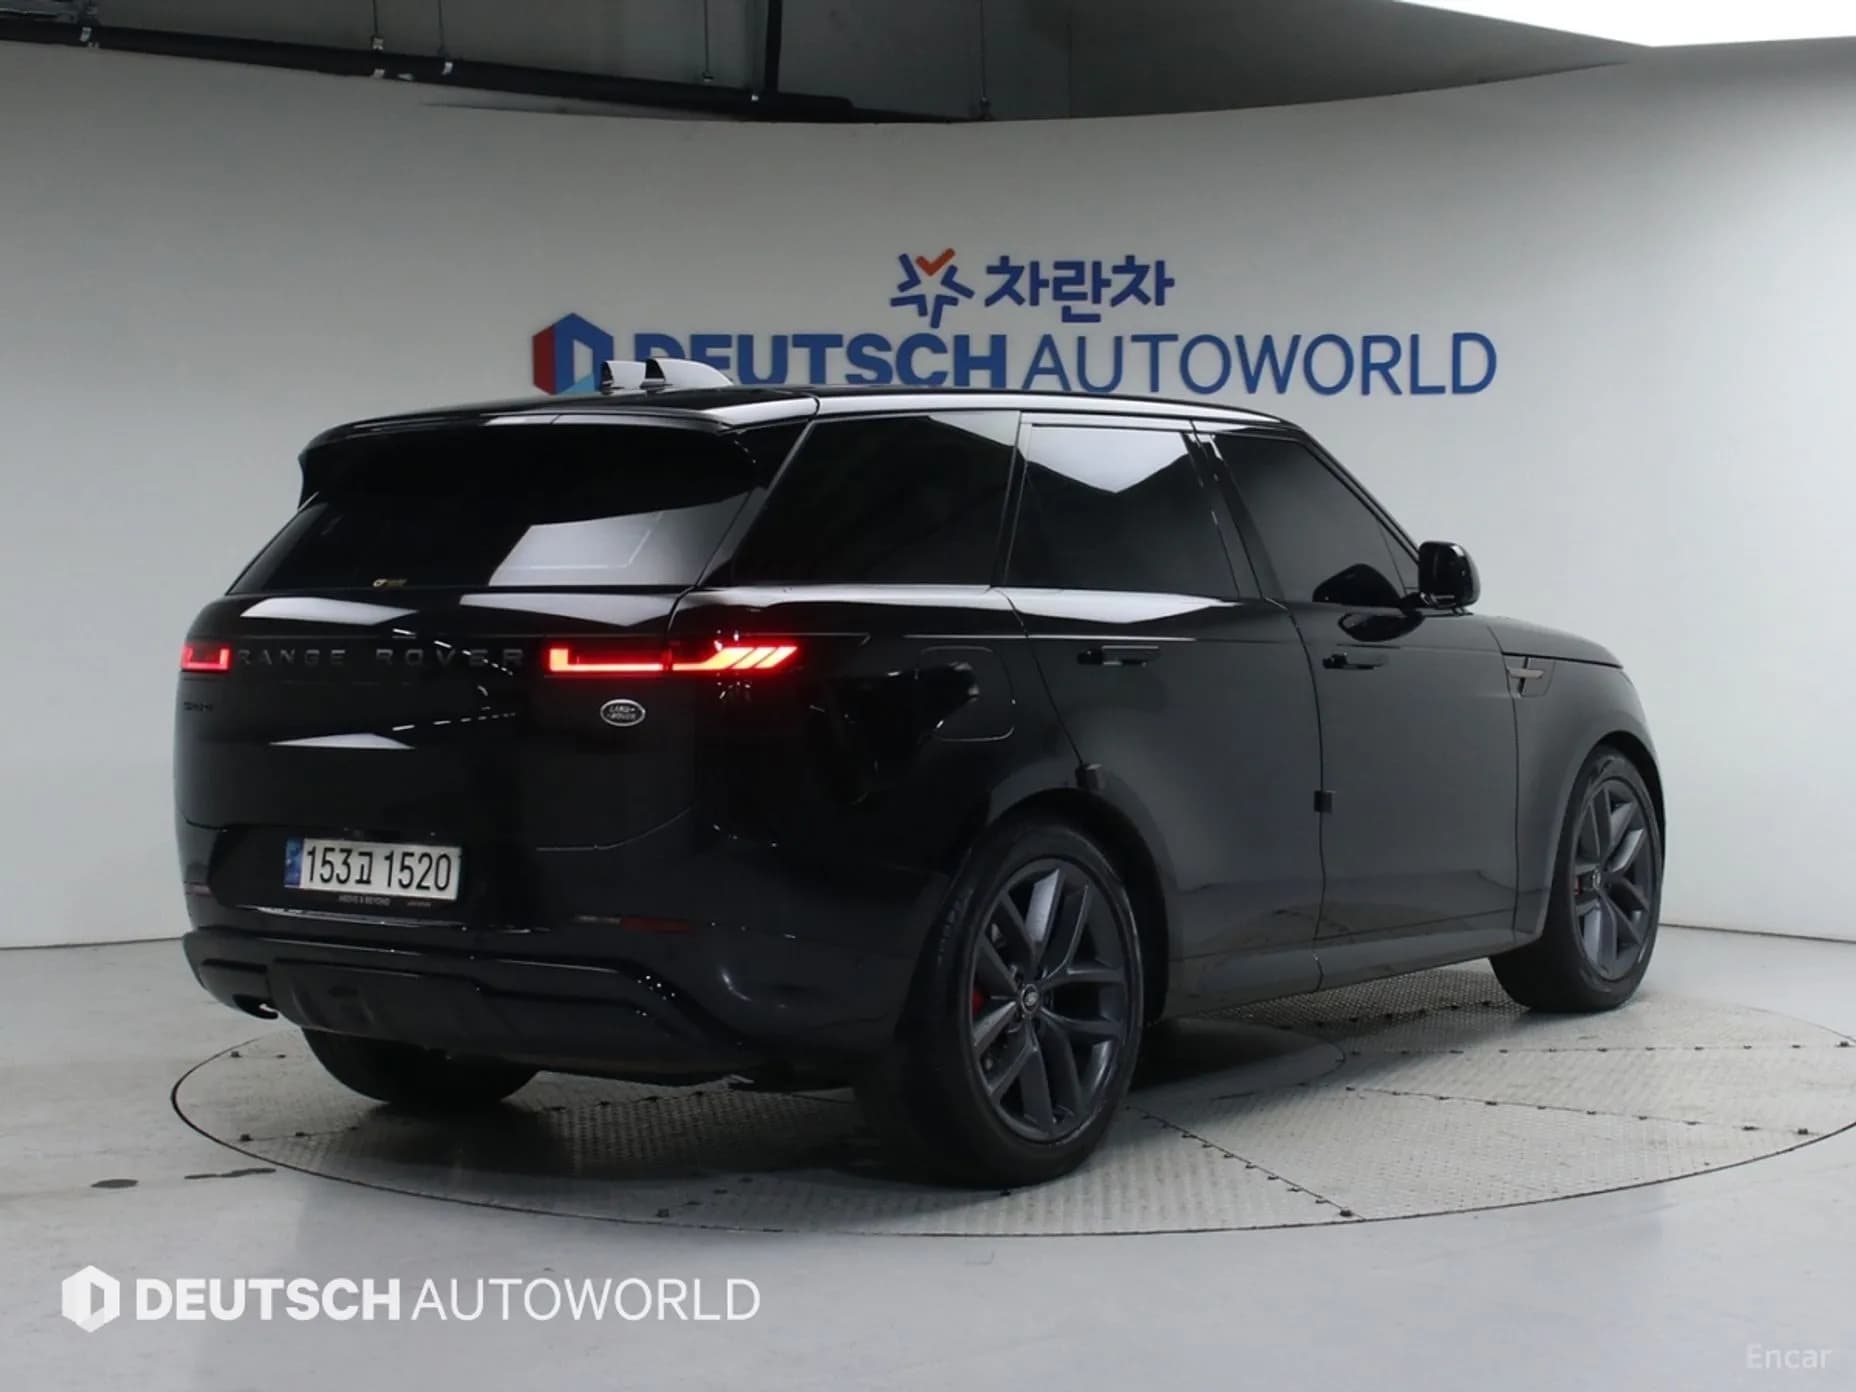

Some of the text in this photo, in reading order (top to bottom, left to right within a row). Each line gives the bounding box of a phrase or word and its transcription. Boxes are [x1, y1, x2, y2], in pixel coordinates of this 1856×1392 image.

[984, 255, 1175, 323] 차란차
[1021, 333, 1498, 395] AUTOWORLD
[236, 647, 525, 667] RANGE ROVER
[306, 845, 452, 891] 153고 1520
